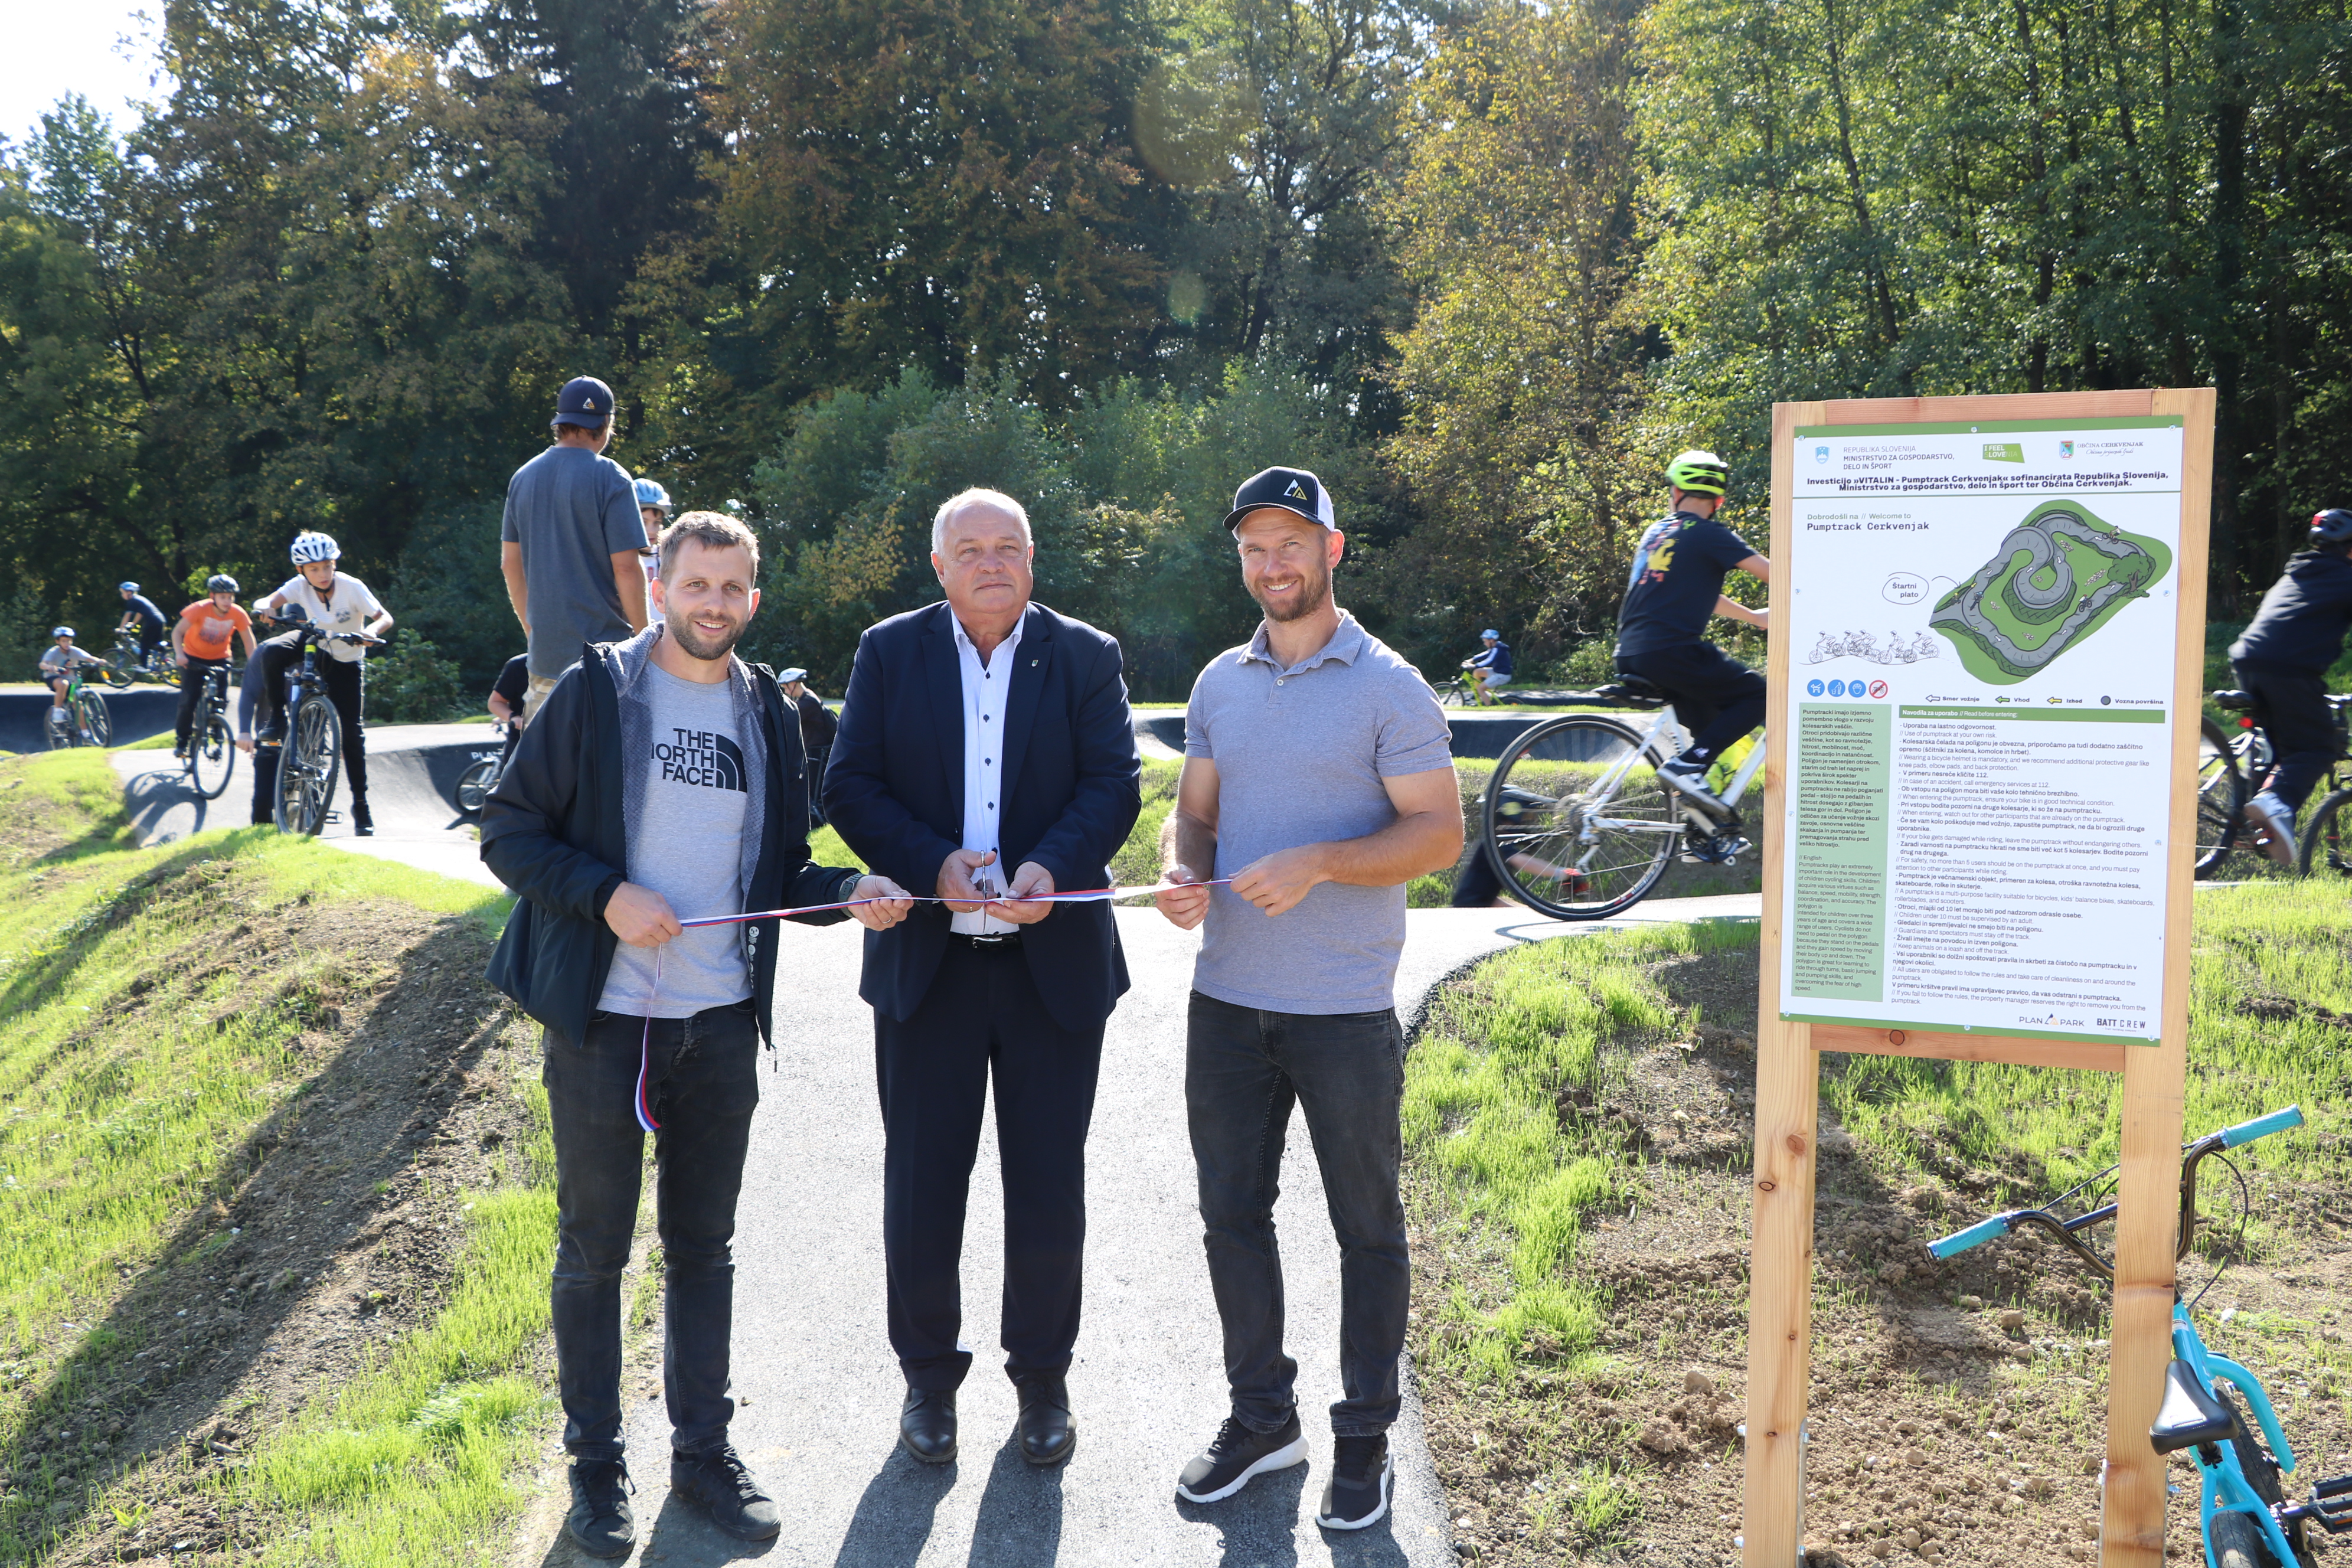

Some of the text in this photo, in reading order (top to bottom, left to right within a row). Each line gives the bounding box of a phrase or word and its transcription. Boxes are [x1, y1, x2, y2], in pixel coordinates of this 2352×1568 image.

[1807, 478, 1851, 486] Investicijo
[1901, 475, 1949, 484] Pumptrack
[1951, 475, 2008, 483] Cerkvenjak«
[2073, 472, 2121, 481] Republika
[2122, 471, 2168, 480] Slovenija,
[1902, 483, 1965, 492] gospodarstvo,
[1999, 481, 2024, 490] šport
[2075, 479, 2132, 488] Cerkvenjak.
[1807, 522, 1929, 532] Pumptrack Cerkvenjak
[673, 728, 714, 750] THE
[662, 762, 714, 787] FACE
[2096, 1018, 2145, 1029] BATT CREW
